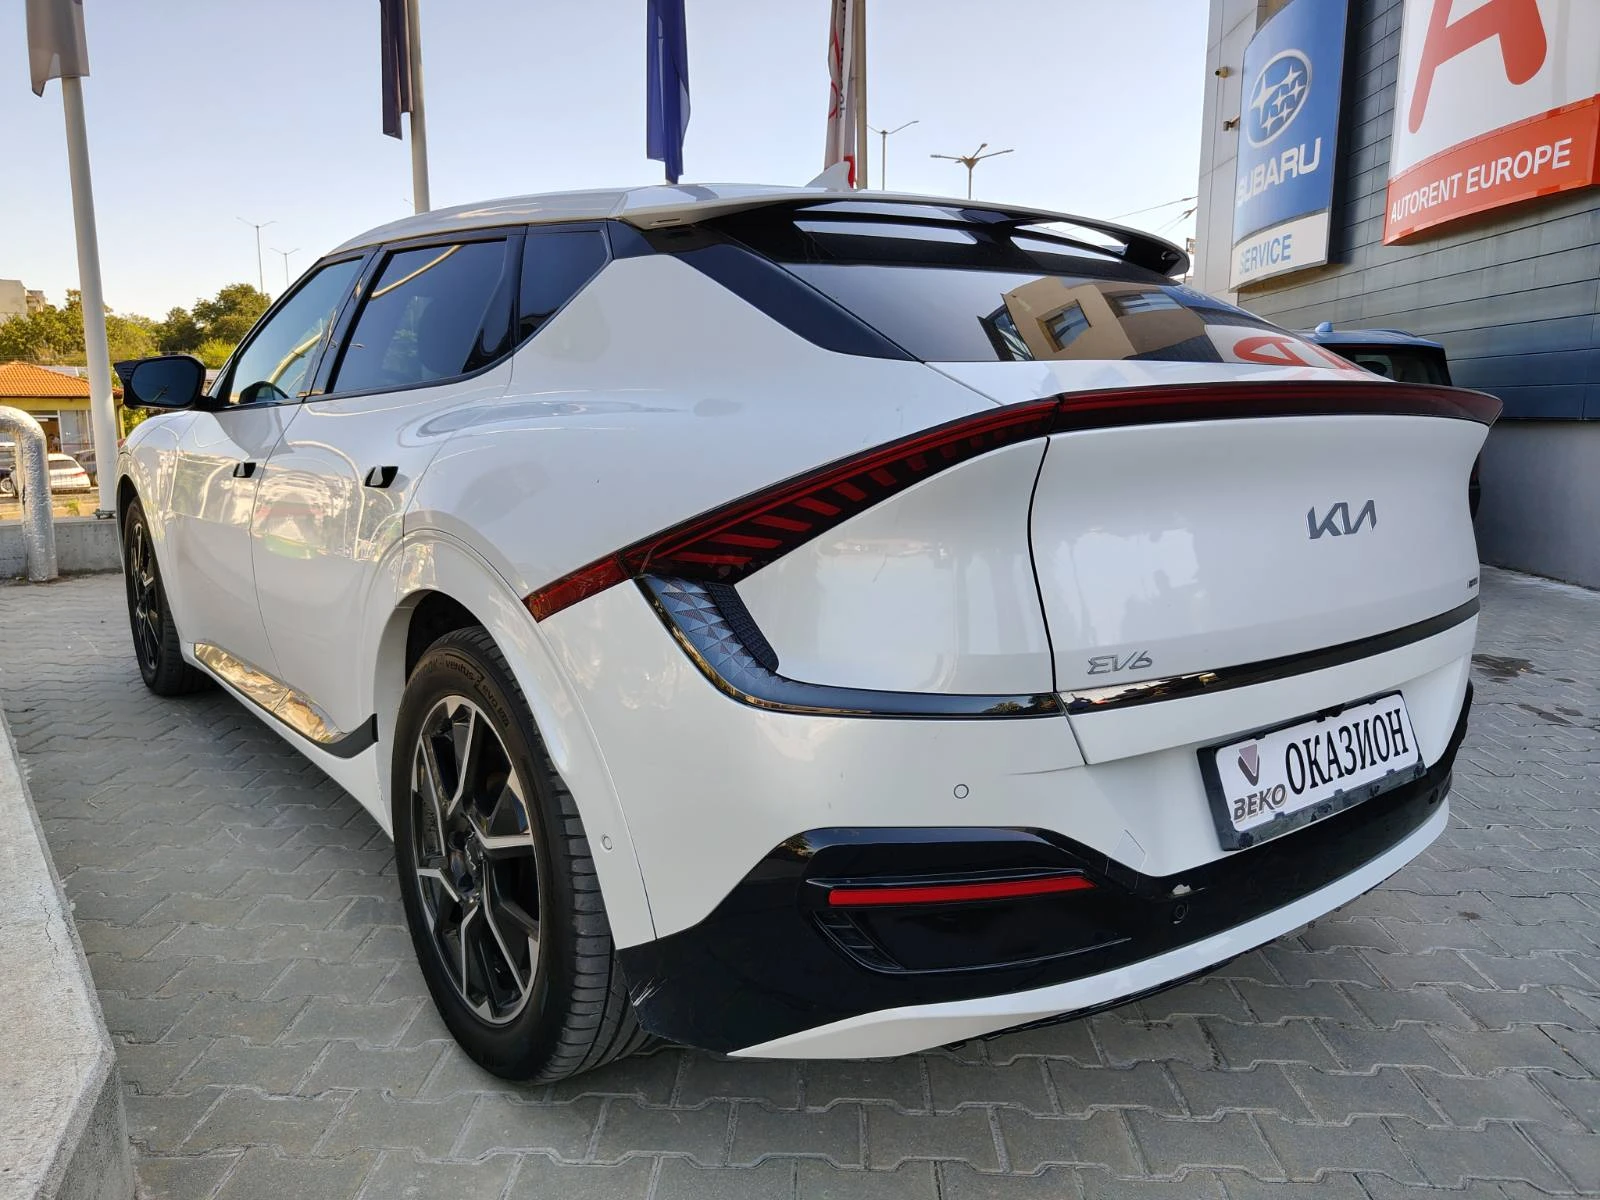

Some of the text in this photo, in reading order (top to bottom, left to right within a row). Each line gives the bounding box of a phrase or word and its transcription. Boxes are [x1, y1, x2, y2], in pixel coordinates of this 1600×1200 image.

[1236, 137, 1322, 207] SUBARU
[1390, 138, 1573, 225] AUTORENT EUROPE
[1239, 233, 1293, 274] SERVICE
[1305, 500, 1376, 539] KIA
[1087, 651, 1153, 675] EV6
[1285, 708, 1408, 795] ОКАЗИОН
